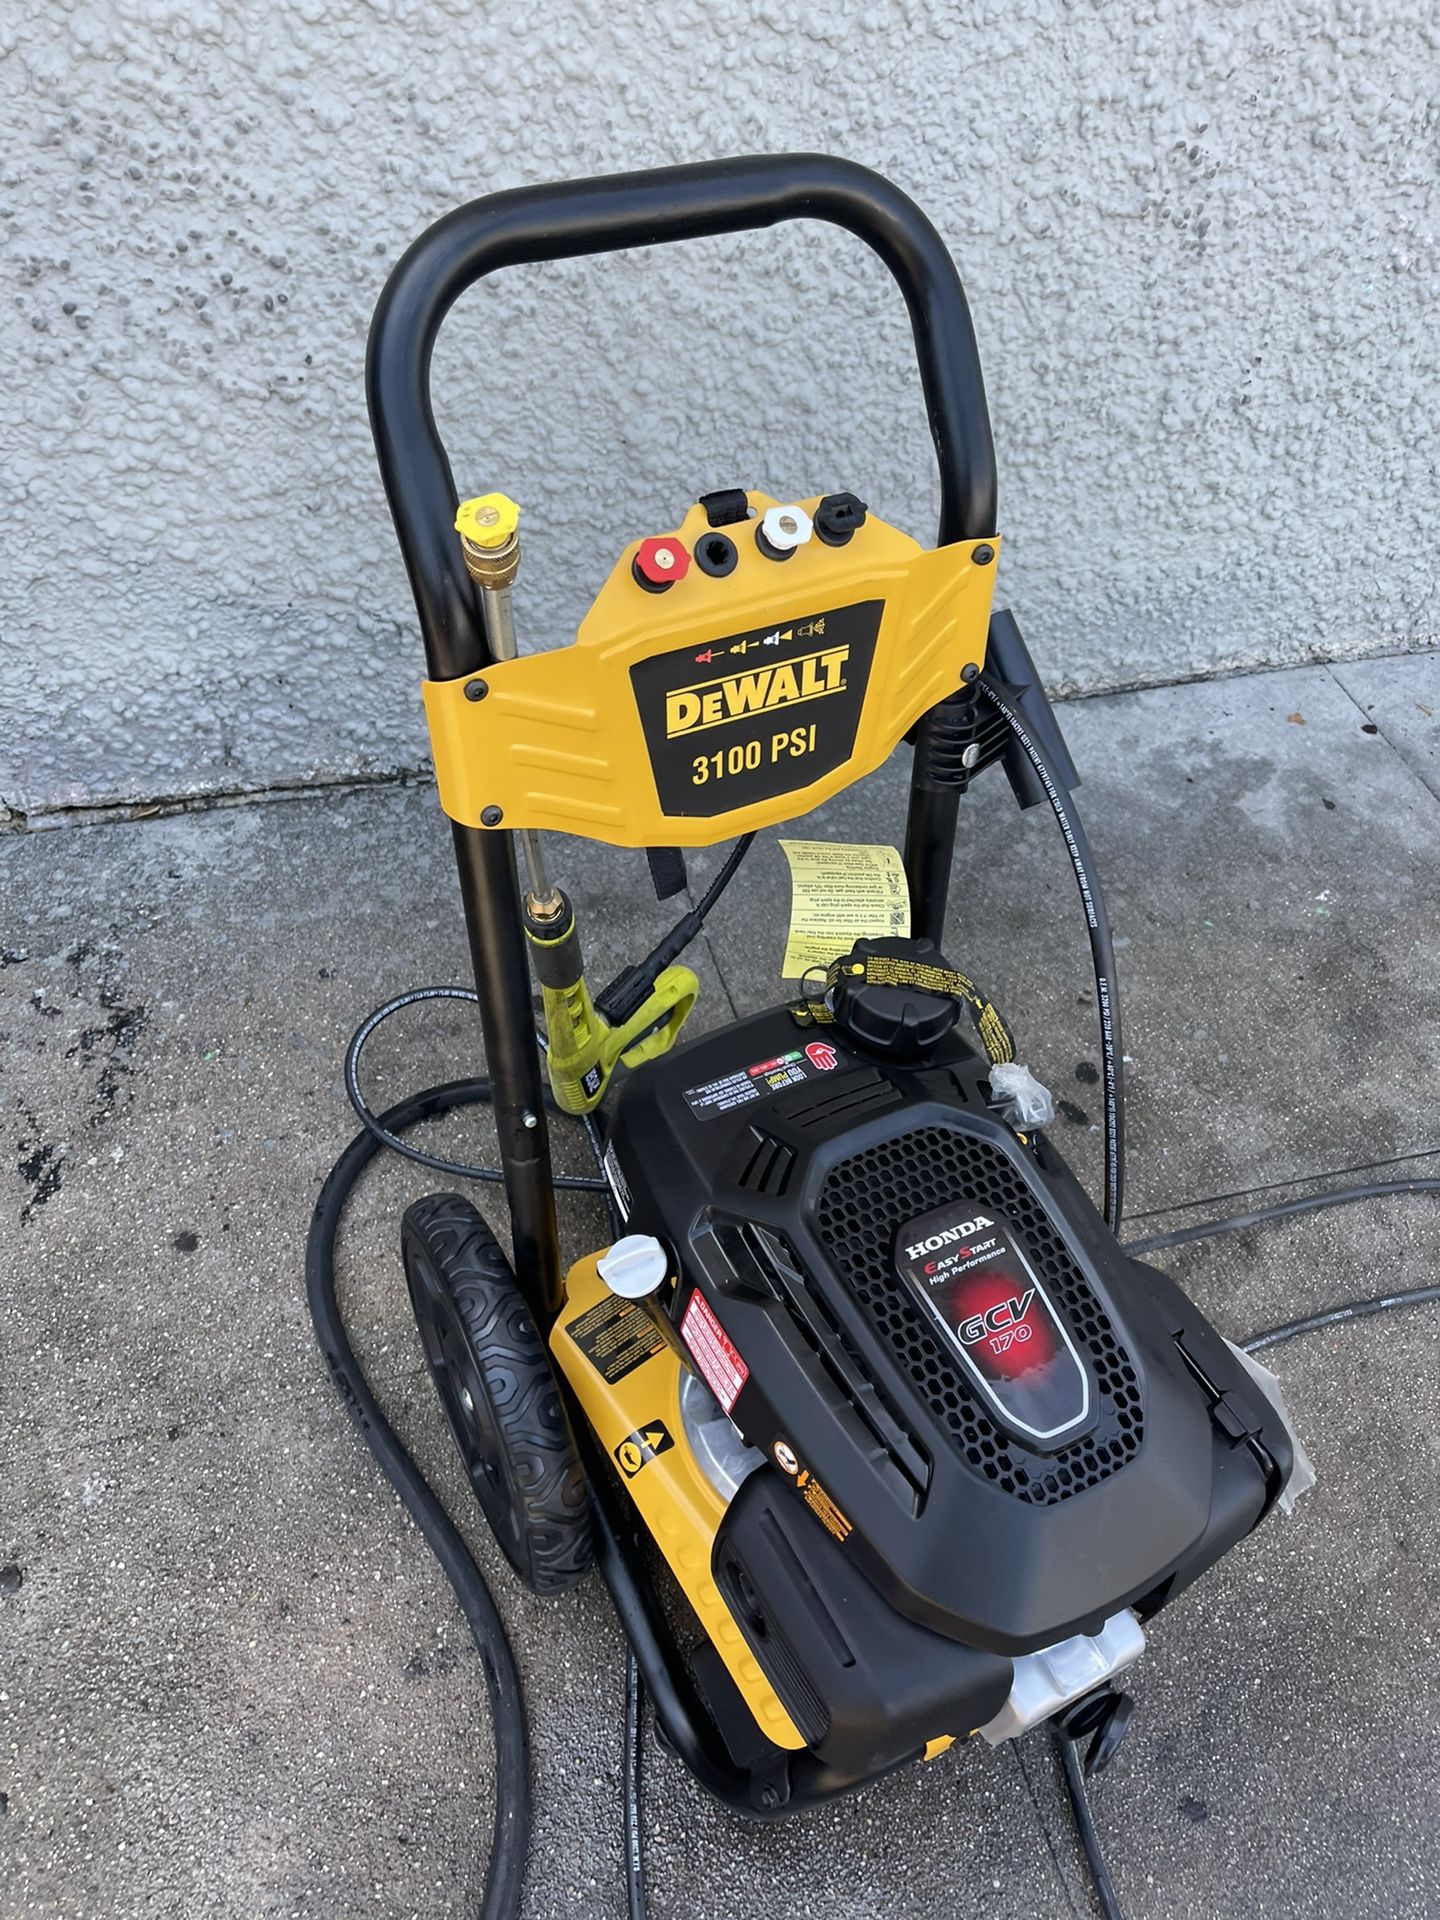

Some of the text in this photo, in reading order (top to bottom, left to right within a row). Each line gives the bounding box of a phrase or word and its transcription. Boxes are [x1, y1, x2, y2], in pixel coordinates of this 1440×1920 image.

[692, 724, 817, 786] 3100 PSI
[1028, 746, 1040, 764] PATENT
[1047, 786, 1056, 798] FOR
[1052, 798, 1062, 812] COLD
[1058, 811, 1069, 830] WATER
[1064, 829, 1074, 844] ONLY
[1069, 844, 1078, 857] KEEP
[1074, 857, 1083, 873] AWAY
[1078, 873, 1088, 889] FROM
[1083, 889, 1091, 900] HOT
[1084, 901, 1098, 928] SURFACES
[765, 1071, 789, 1086] PUMP!
[787, 1066, 802, 1077] YOU
[770, 1071, 807, 1091] LOOK BEFORE
[905, 1216, 994, 1260] HONDA
[929, 1246, 1006, 1285] High Performance
[700, 1302, 722, 1338] DANGER
[958, 1288, 1036, 1345] GCV
[990, 1324, 1032, 1354] 170
